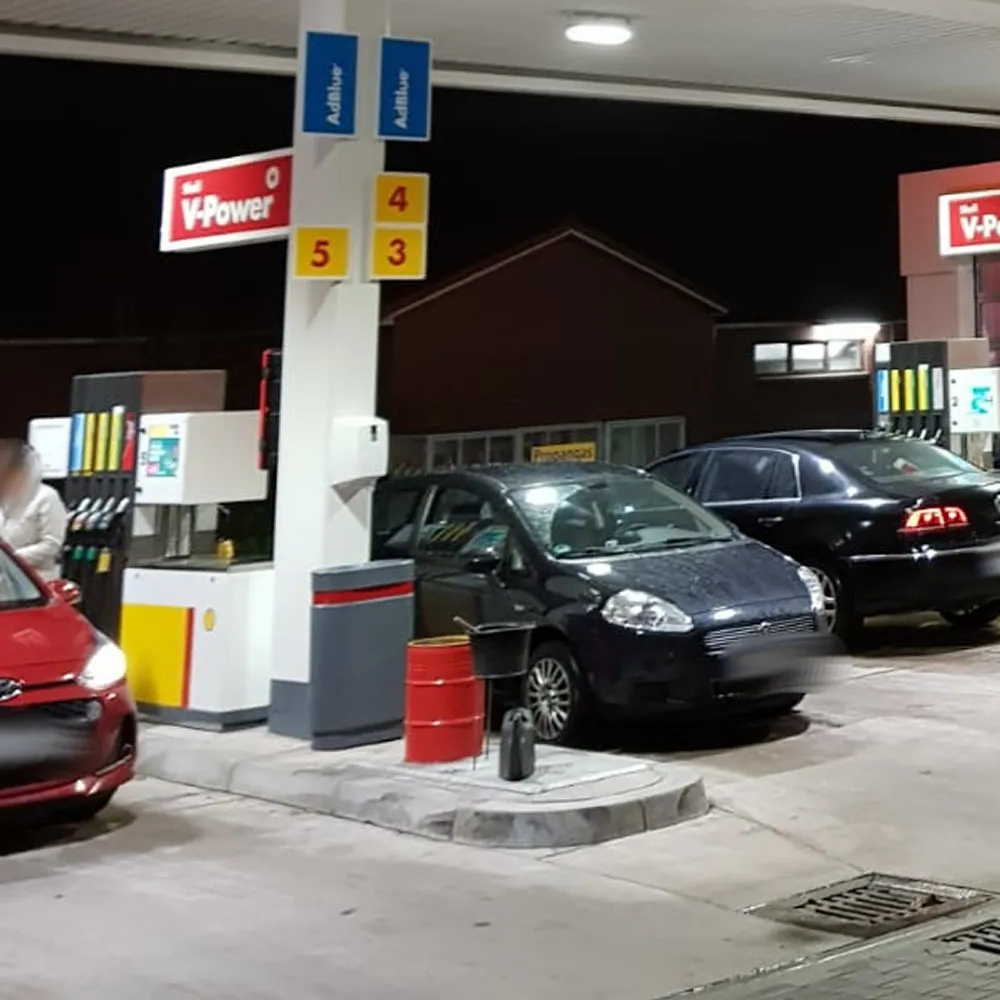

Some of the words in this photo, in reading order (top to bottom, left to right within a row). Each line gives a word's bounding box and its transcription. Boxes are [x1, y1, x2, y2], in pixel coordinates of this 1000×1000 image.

[181, 194, 275, 231] V-Power
[387, 185, 409, 212] 4
[310, 240, 331, 268] 5
[387, 238, 407, 266] 3
